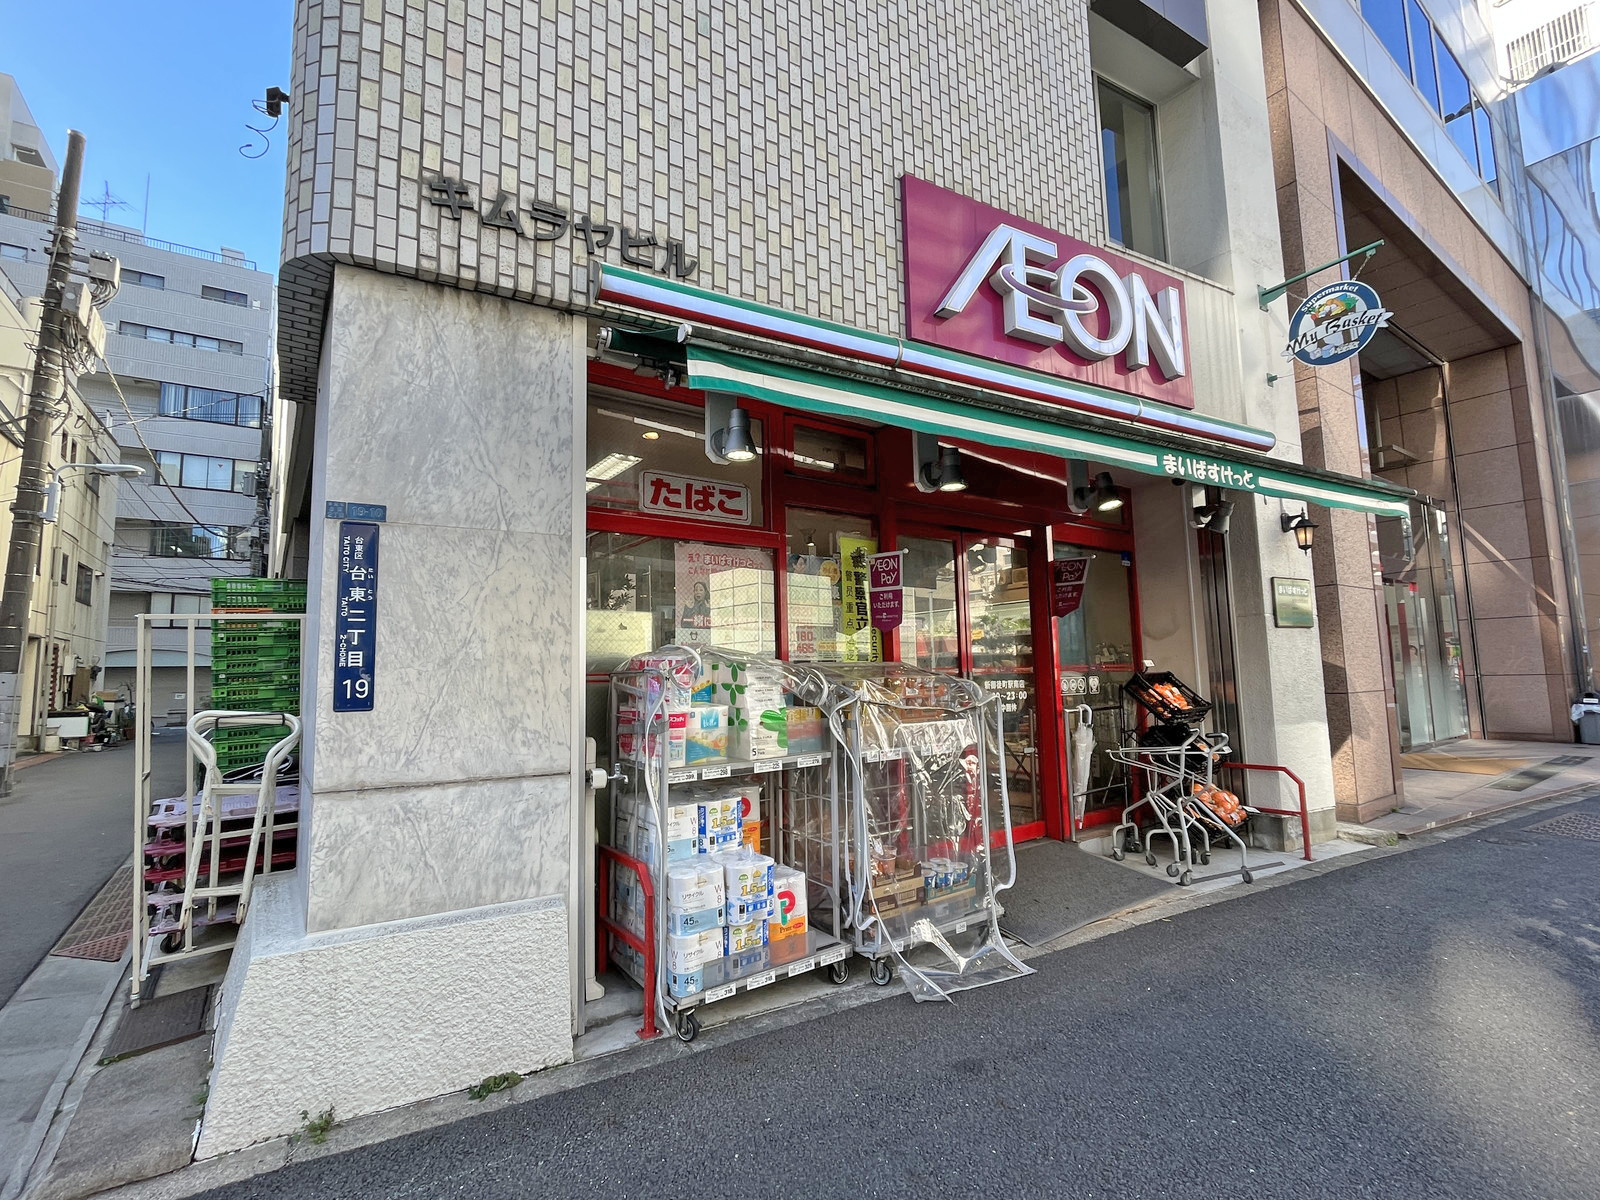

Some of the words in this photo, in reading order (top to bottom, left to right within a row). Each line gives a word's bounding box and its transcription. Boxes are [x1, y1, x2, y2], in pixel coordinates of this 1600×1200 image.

[430, 176, 698, 277] キムラヤビル
[1301, 283, 1359, 313] Supermarket
[1286, 331, 1319, 355] My
[1325, 310, 1384, 335] Basket
[1162, 453, 1257, 490] まいばすけっと
[650, 477, 745, 516] たばこ
[343, 535, 351, 555] TAITO
[354, 536, 365, 560] 台東区
[342, 556, 350, 574] CITY
[873, 558, 898, 572] AEON
[881, 572, 898, 584] Pay
[1278, 585, 1309, 596] まいばすけっと
[340, 596, 349, 616] TAITO
[347, 565, 368, 667] 台東二丁目
[338, 634, 347, 667] 2-CHOME
[342, 679, 369, 699] 19
